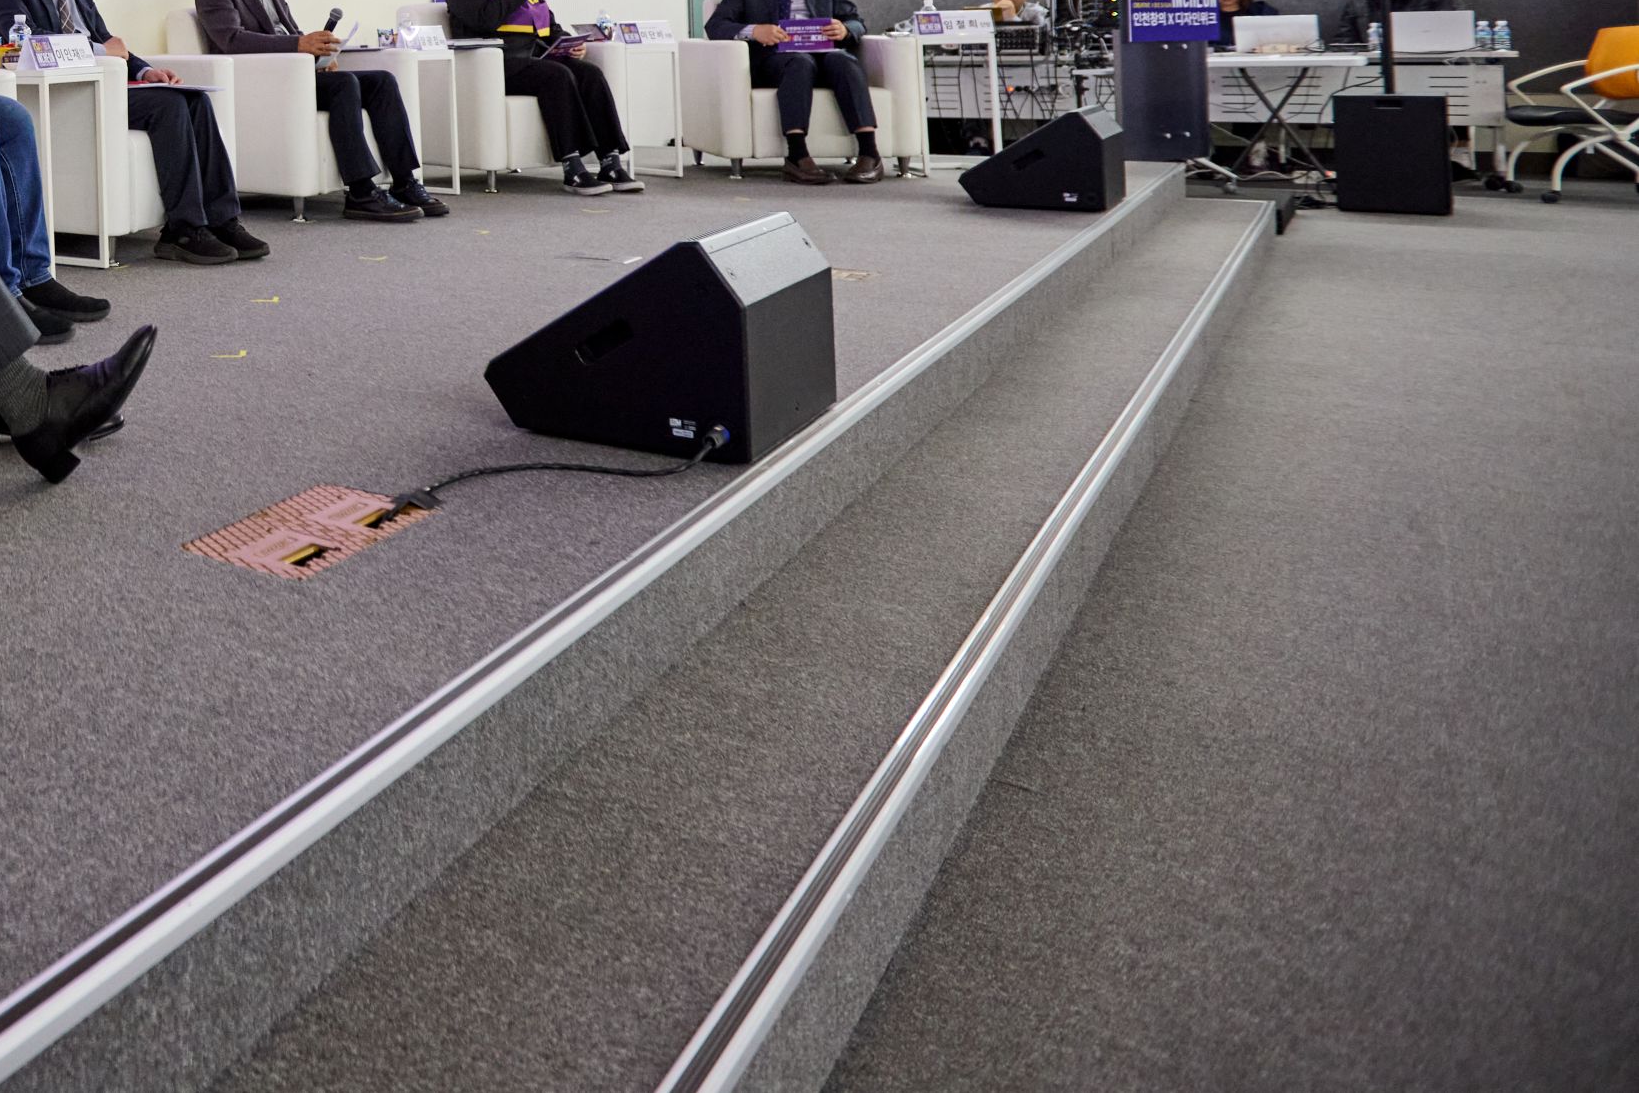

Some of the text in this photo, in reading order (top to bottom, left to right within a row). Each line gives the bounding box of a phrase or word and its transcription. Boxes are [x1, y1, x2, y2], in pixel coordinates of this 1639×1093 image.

[1132, 10, 1219, 27] 인천창의 X 디자인위크
